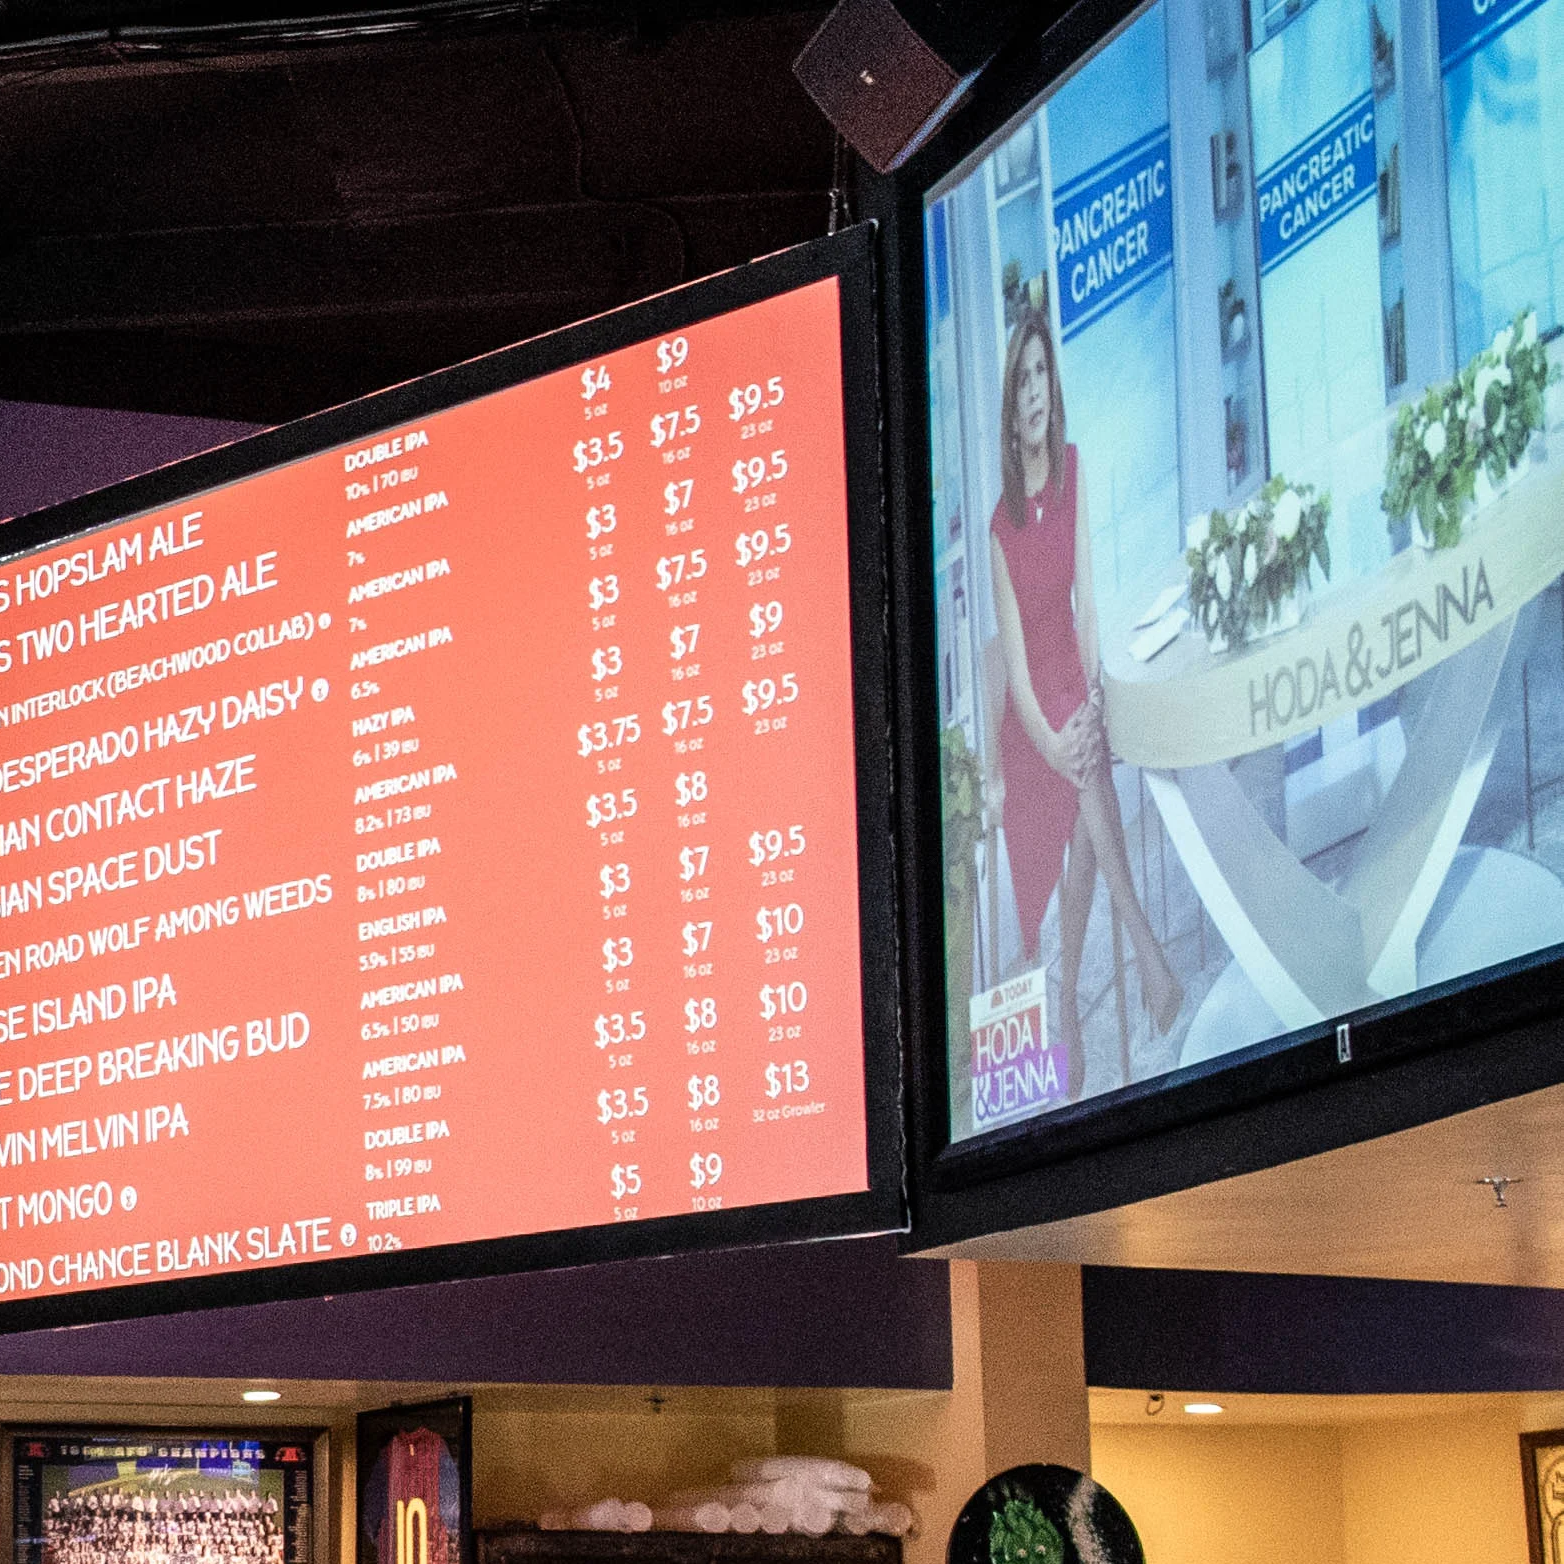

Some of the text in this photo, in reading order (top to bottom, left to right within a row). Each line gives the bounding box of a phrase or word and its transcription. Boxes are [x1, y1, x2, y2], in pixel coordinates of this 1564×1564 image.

[1260, 112, 1373, 221] PANCREATIC
[1050, 159, 1166, 263] PANCREATIC
[1278, 164, 1356, 241] CANCER
[1071, 220, 1149, 302] CANCER
[581, 365, 612, 401] $4
[656, 336, 688, 374] $9
[649, 406, 701, 448] $7.5
[728, 377, 785, 422] $9.5
[572, 432, 624, 474] $3.5
[16, 534, 142, 601] HOPSLAM
[149, 511, 203, 560] ALE
[17, 621, 74, 664] TWO
[79, 574, 214, 645] HEARTED
[221, 551, 278, 601] ALE
[11, 676, 105, 727] INTERLOCK
[107, 638, 231, 698] (BEACHWOOD
[234, 611, 315, 654] COLLAB)
[1250, 564, 1494, 737] HODA & JENNA
[144, 706, 215, 753] HAZY
[222, 677, 304, 729] DAISY
[577, 714, 640, 758] $3.75
[46, 776, 170, 839] CONTACT
[175, 754, 257, 806] HAZE
[48, 857, 137, 906] SPACE
[143, 829, 224, 876] DUST
[26, 936, 83, 972] ROAD
[88, 916, 151, 955] WOLF
[155, 893, 239, 941] AMONG
[243, 873, 332, 916] WEEDS
[755, 903, 804, 943] $10
[33, 985, 126, 1034] ISLAND
[132, 973, 177, 1015] IPA
[18, 1057, 92, 1098] DEEP
[98, 1024, 239, 1085] BREAKING
[245, 1010, 310, 1056] BUD
[975, 1014, 1034, 1071] HODA
[764, 1060, 810, 1098] $13
[41, 1110, 139, 1161] MELVIN
[145, 1102, 189, 1142] IPA
[18, 1180, 113, 1226] MONGO
[610, 1163, 641, 1200] $5
[49, 1241, 151, 1286] CHANCE
[156, 1227, 240, 1270] BLANK
[245, 1216, 332, 1261] SLATE
